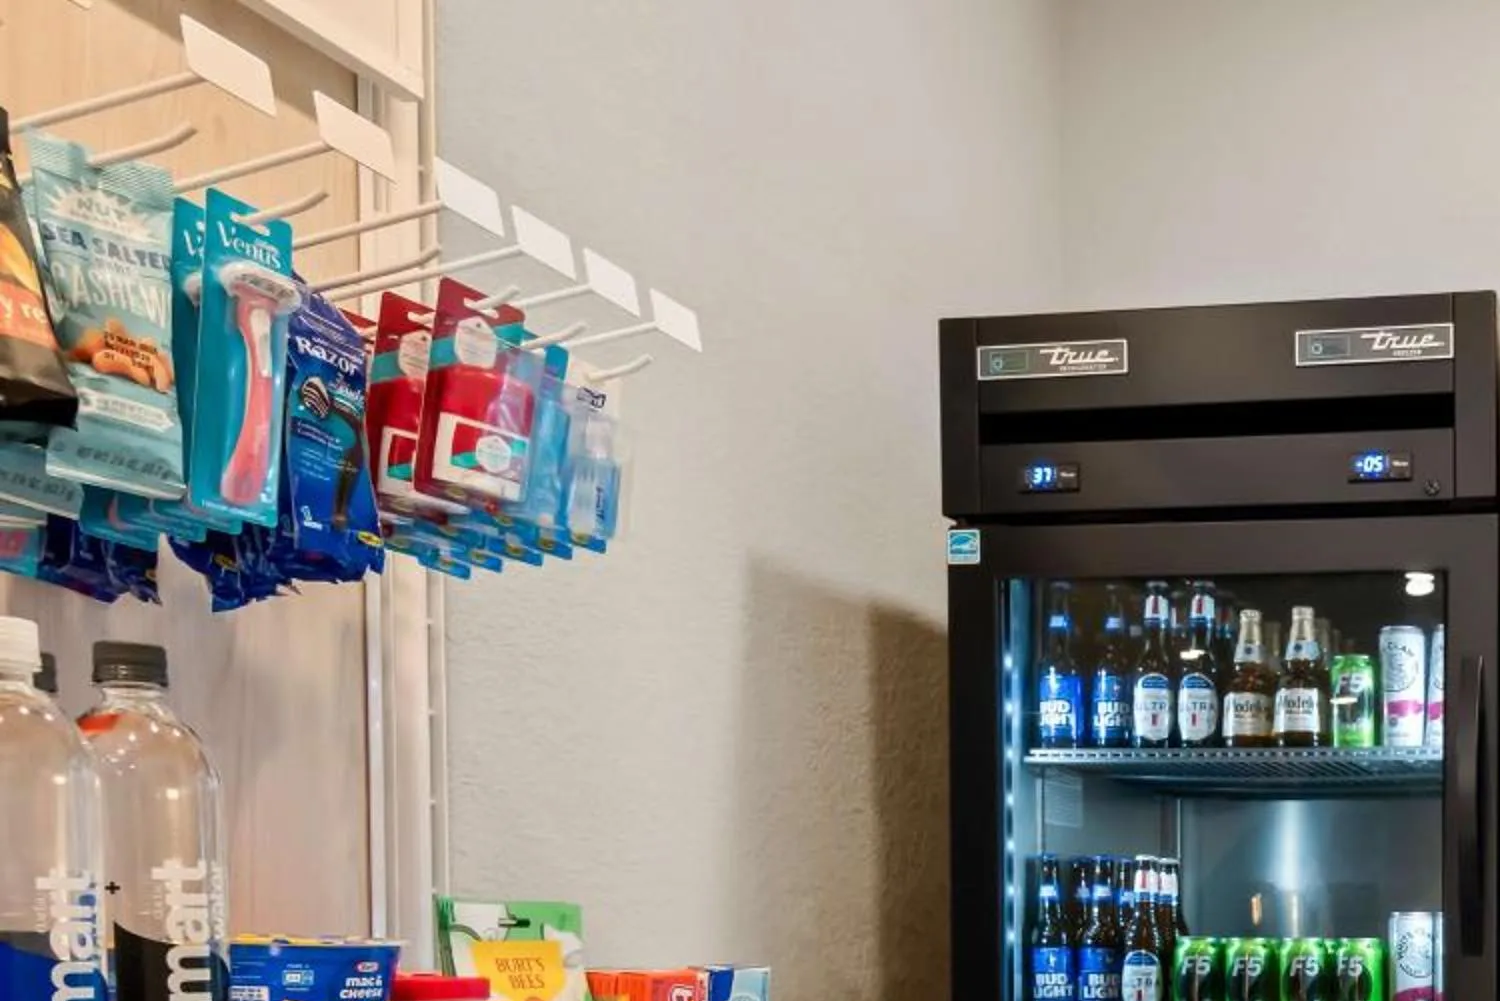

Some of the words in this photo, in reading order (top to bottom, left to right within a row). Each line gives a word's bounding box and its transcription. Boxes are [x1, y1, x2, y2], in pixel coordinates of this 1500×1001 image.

[217, 220, 281, 269] Venus
[295, 335, 359, 375] Razor
[1033, 467, 1051, 484] 37
[495, 957, 545, 973] BURT'S
[1233, 956, 1261, 976] F5
[508, 974, 545, 990] BEES
[1035, 973, 1067, 984] BUD
